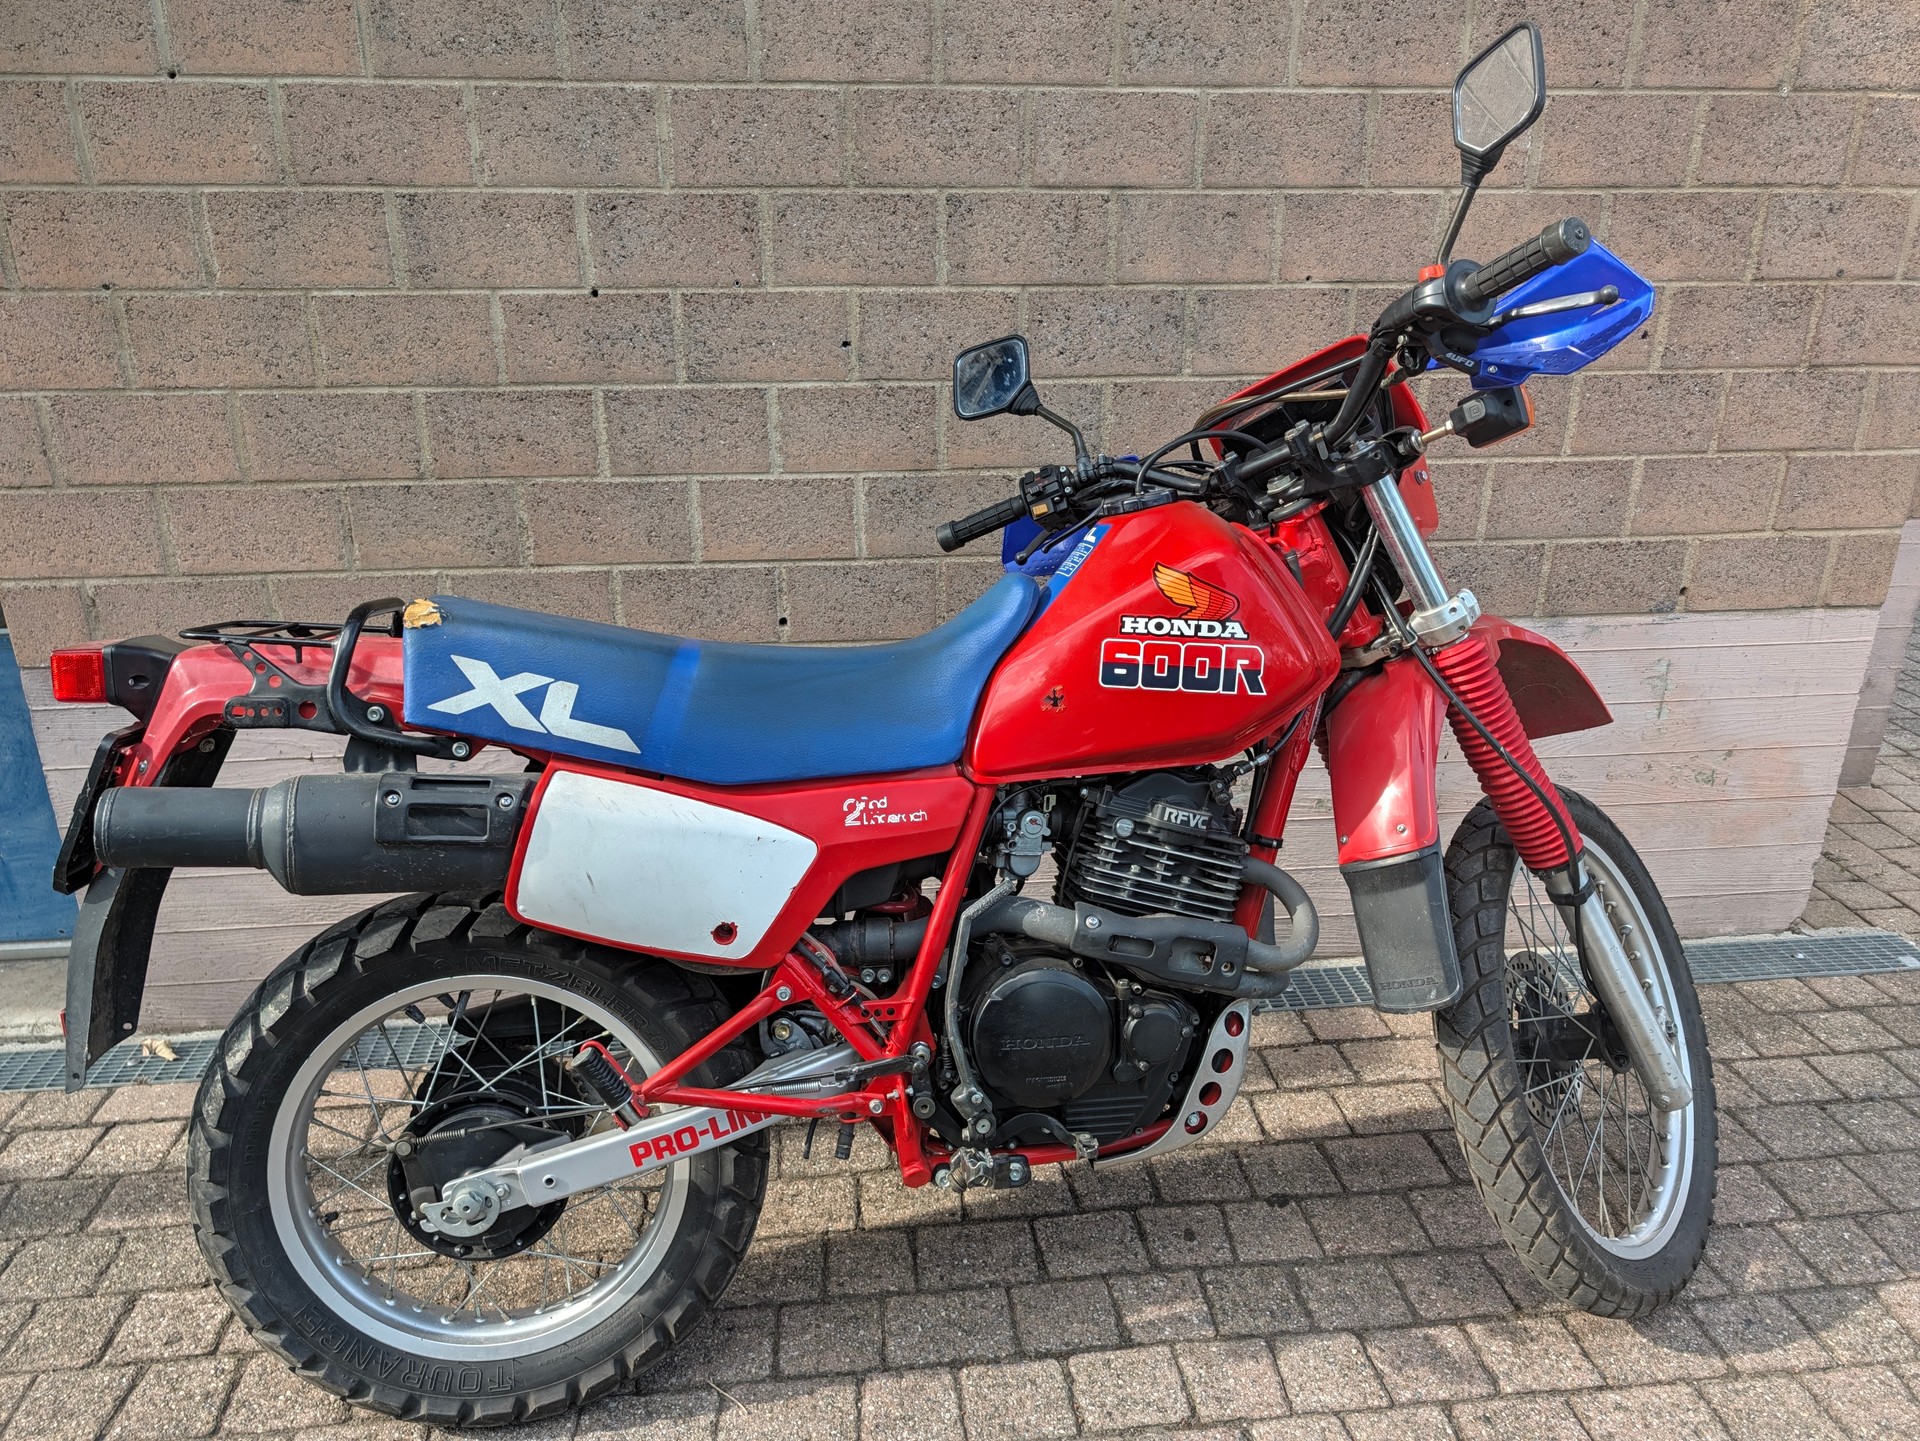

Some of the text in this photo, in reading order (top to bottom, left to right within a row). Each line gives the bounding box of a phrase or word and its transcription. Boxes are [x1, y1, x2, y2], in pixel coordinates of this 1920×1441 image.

[1121, 616, 1249, 639] HONDA
[1099, 638, 1267, 695] 600R
[427, 654, 641, 754] XL
[1163, 807, 1209, 829] RFVC
[466, 956, 650, 1032] METZELER
[1380, 976, 1439, 990] HONDA
[1001, 1036, 1090, 1051] HONDA
[628, 1109, 775, 1168] PRO-LIN
[295, 1303, 513, 1394] TOURANCE
